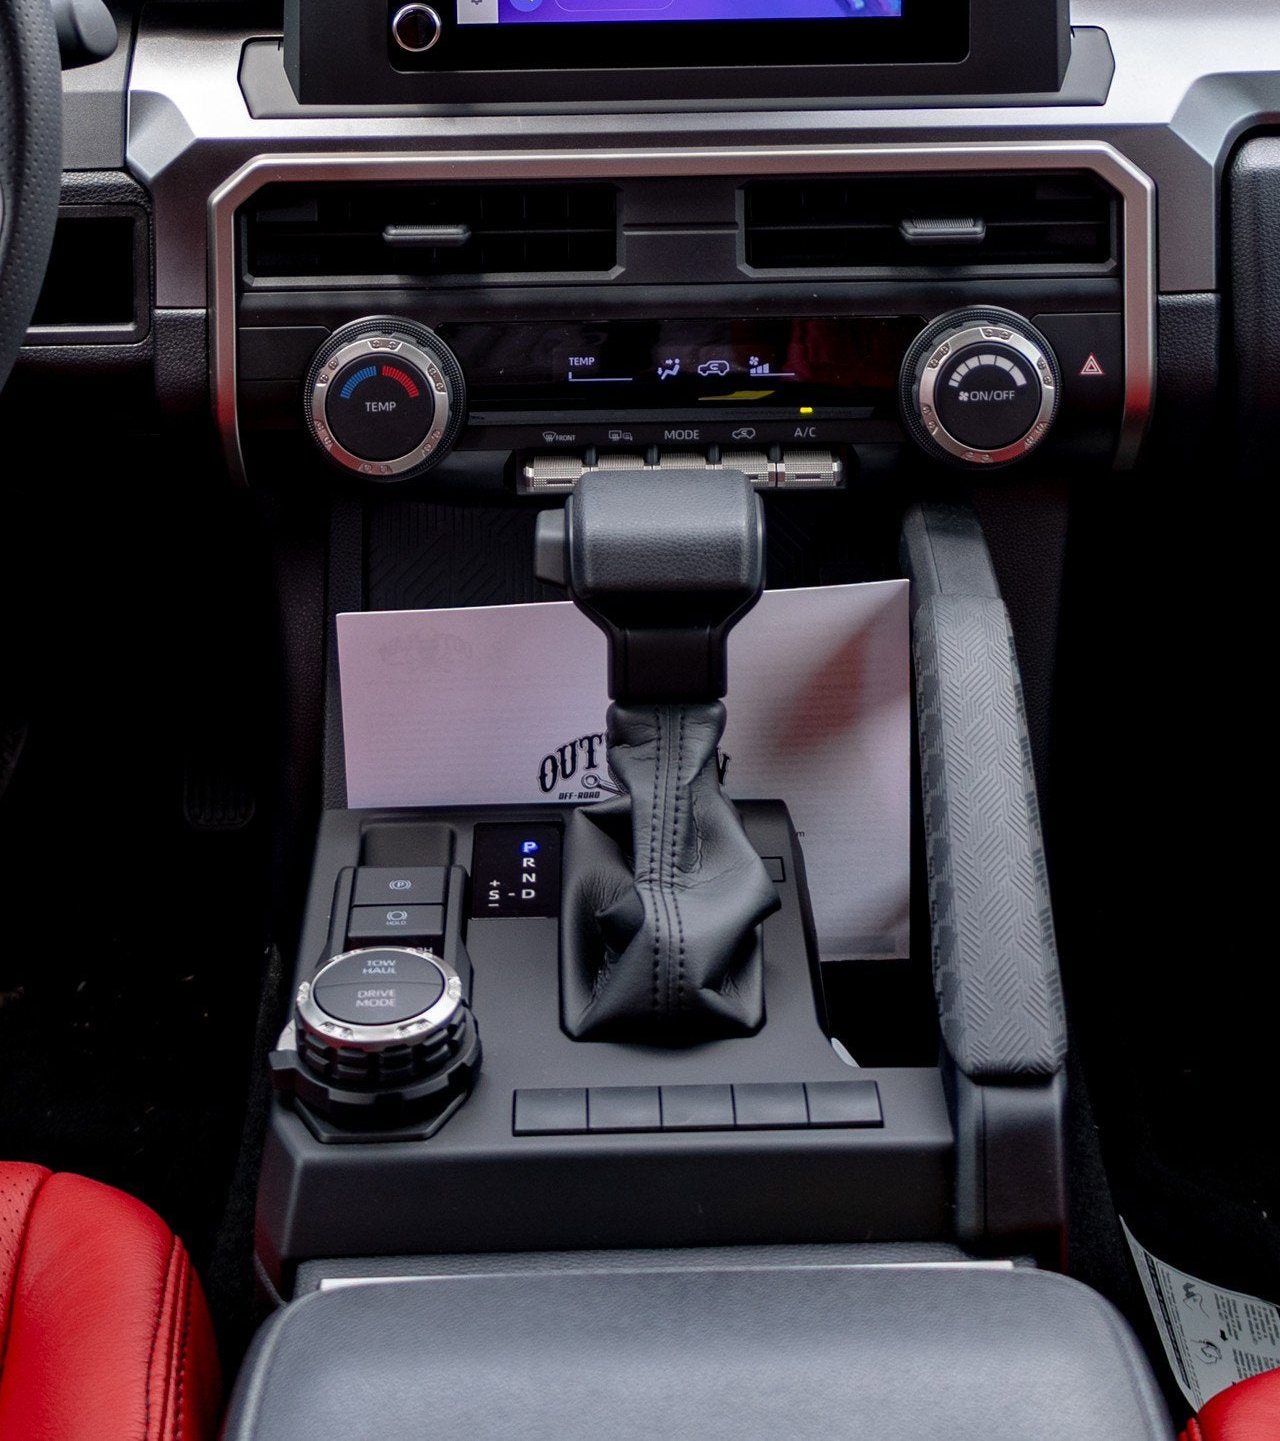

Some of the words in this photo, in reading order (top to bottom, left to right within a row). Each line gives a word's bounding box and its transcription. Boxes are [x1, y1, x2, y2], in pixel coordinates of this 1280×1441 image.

[569, 357, 595, 366] TEMP
[969, 390, 1016, 402] ON/OFF
[365, 401, 397, 413] TEMP
[664, 429, 700, 440] MODE
[793, 427, 816, 438] A/C
[556, 434, 576, 442] FRONT
[558, 791, 600, 800] OFF-ROAD
[523, 842, 537, 853] P
[522, 858, 536, 868] R
[522, 873, 536, 883] N
[488, 890, 500, 900] S
[521, 889, 536, 899] D
[357, 989, 396, 998] DRIVE
[356, 999, 396, 1007] MODE
